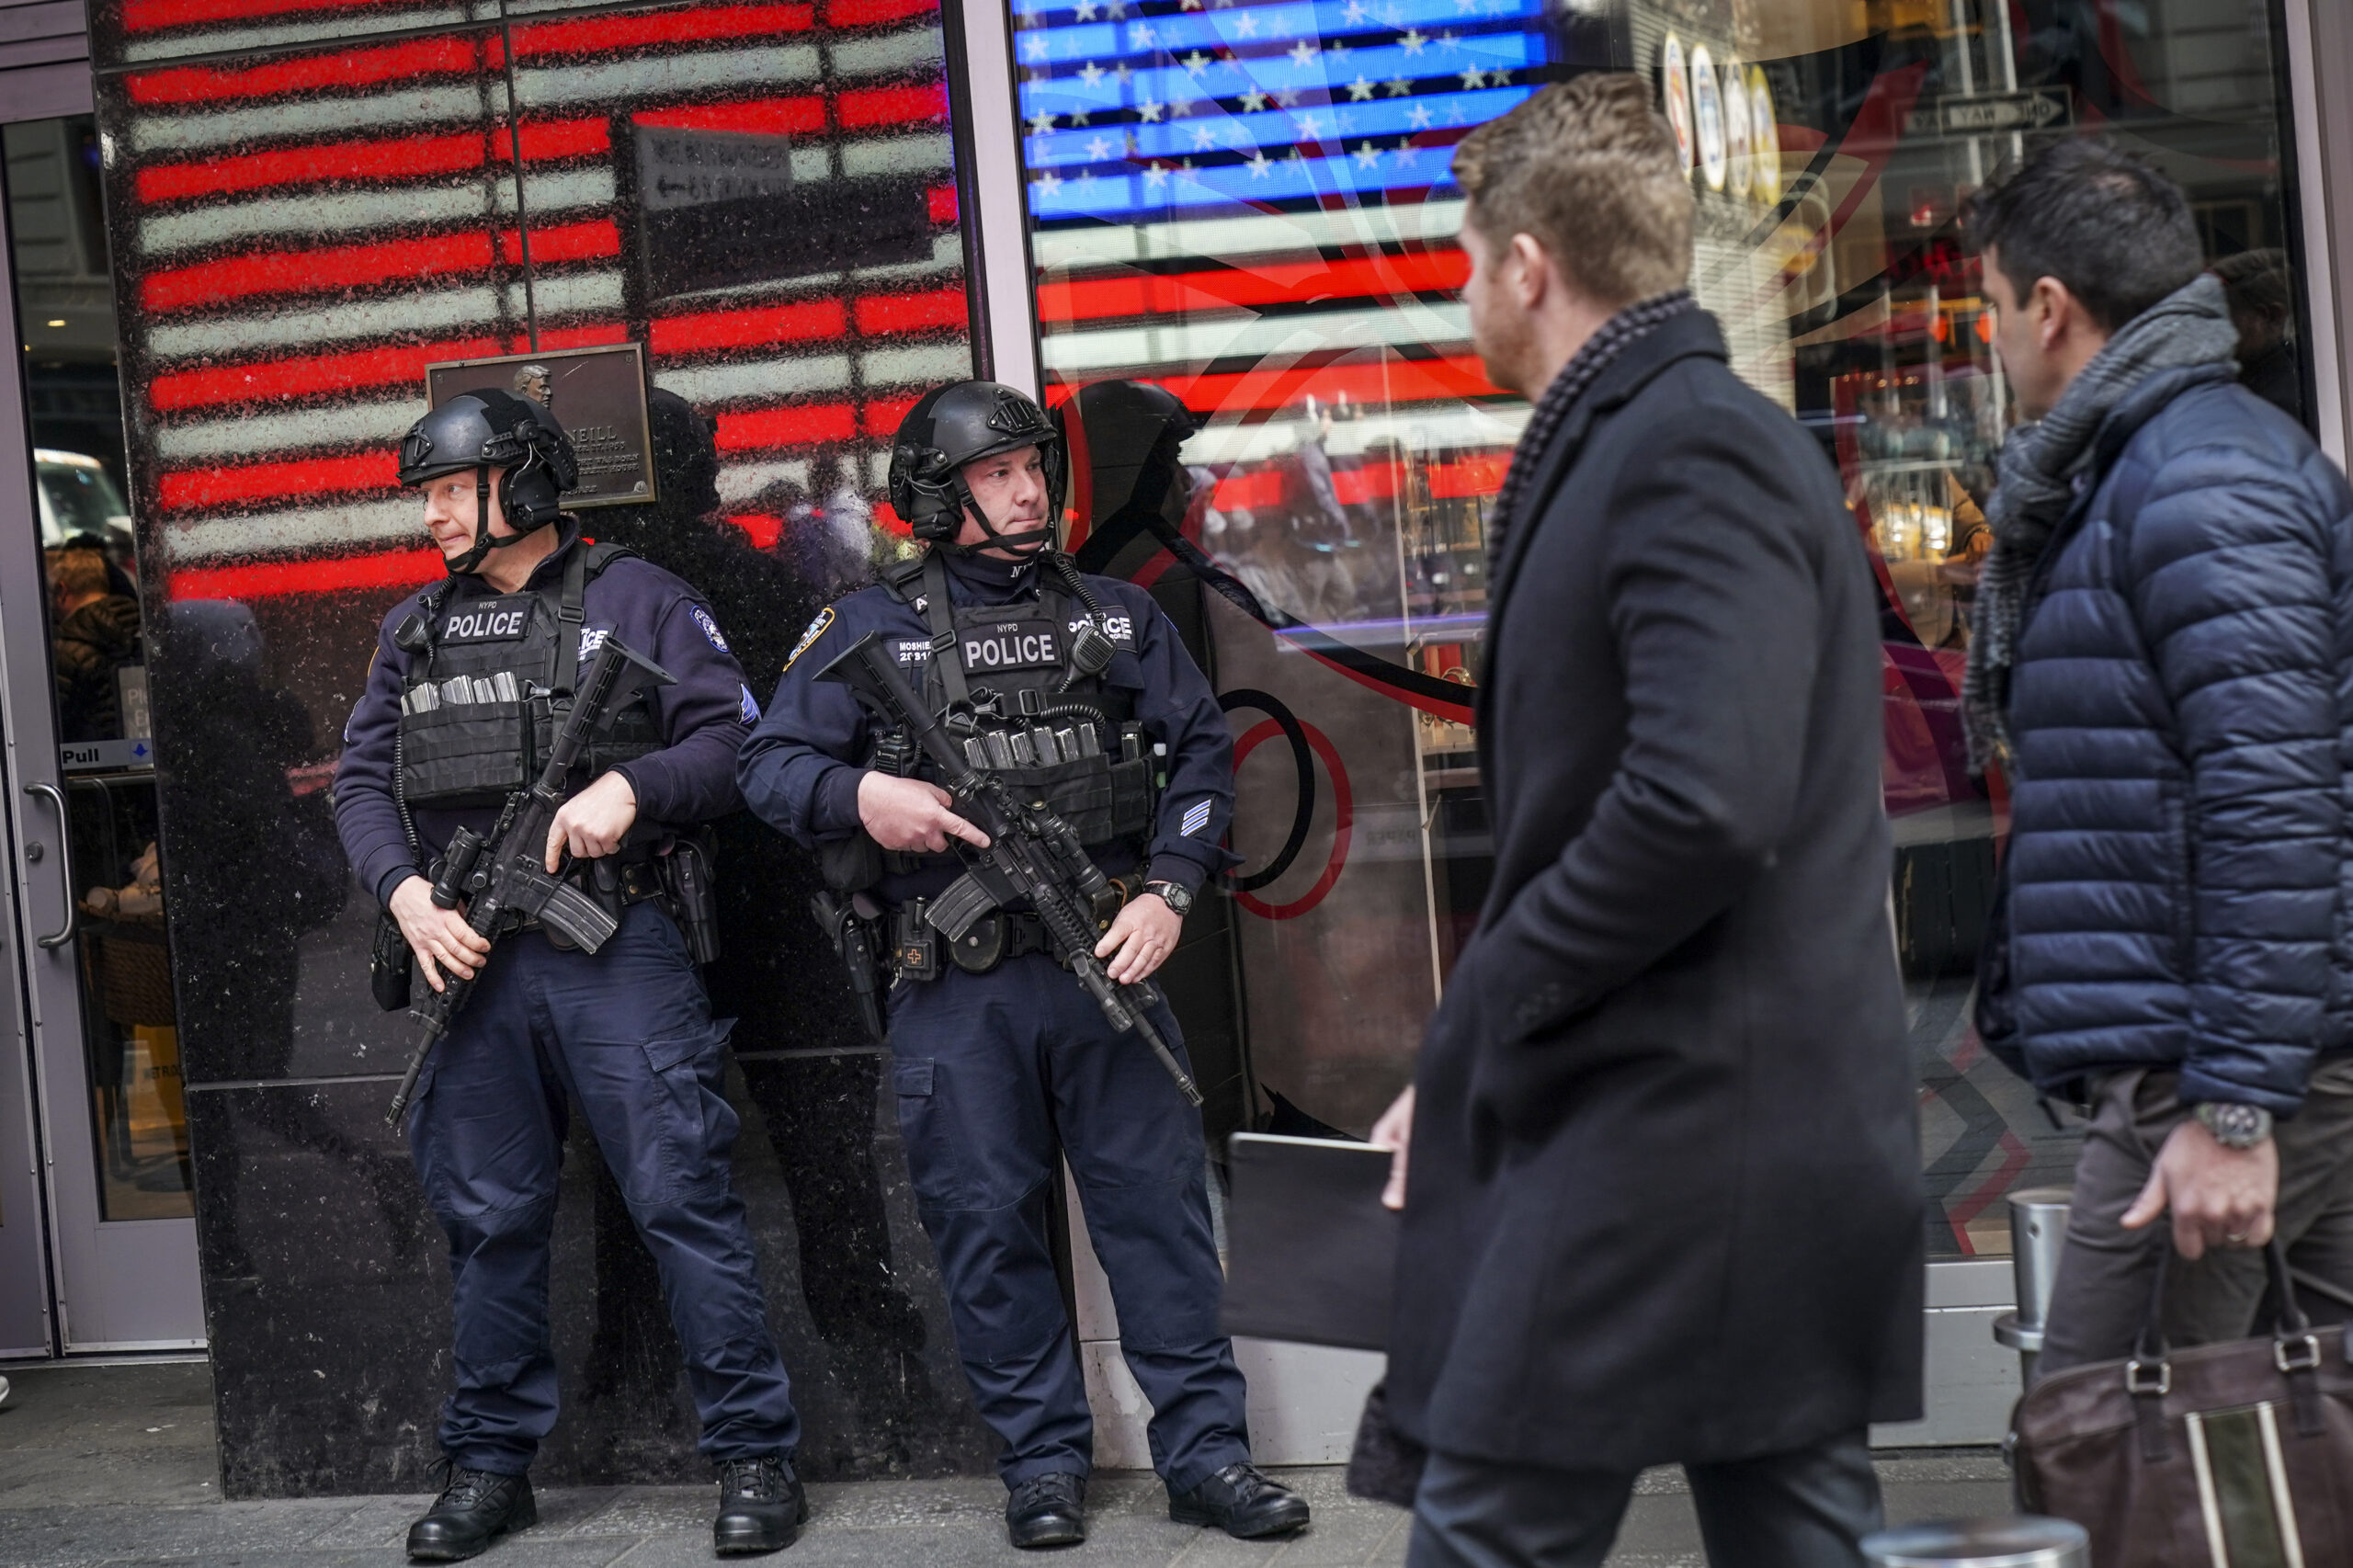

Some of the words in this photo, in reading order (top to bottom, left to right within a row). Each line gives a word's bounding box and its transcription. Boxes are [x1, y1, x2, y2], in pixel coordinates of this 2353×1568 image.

[478, 601, 496, 609] NYPD
[444, 611, 523, 639] POLICE
[996, 623, 1018, 633] NYPD
[580, 630, 608, 650] ICE
[899, 641, 932, 652] MOSHIE
[965, 634, 1055, 668] POLICE
[63, 748, 99, 764] Pull
